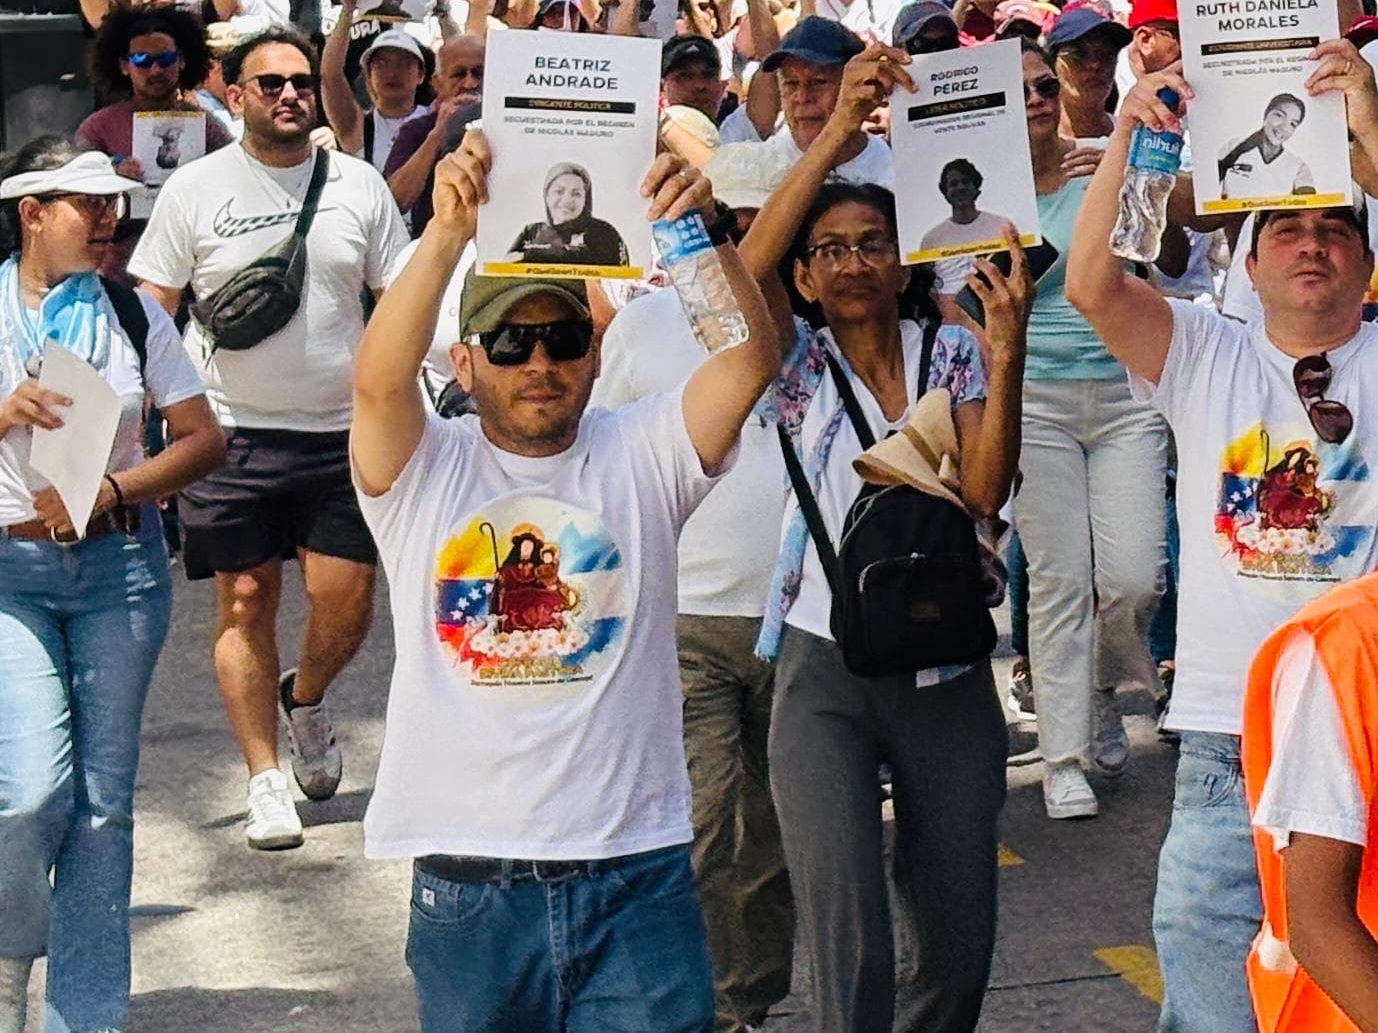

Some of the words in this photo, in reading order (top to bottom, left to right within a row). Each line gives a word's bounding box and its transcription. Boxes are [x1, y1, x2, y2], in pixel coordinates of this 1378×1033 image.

[1196, 1, 1240, 17] RUTH
[1218, 14, 1300, 32] MORALES
[535, 56, 612, 72] BEATRIZ
[526, 74, 619, 90] ANDRADE
[565, 118, 584, 126] POR
[576, 128, 615, 138] MADURO
